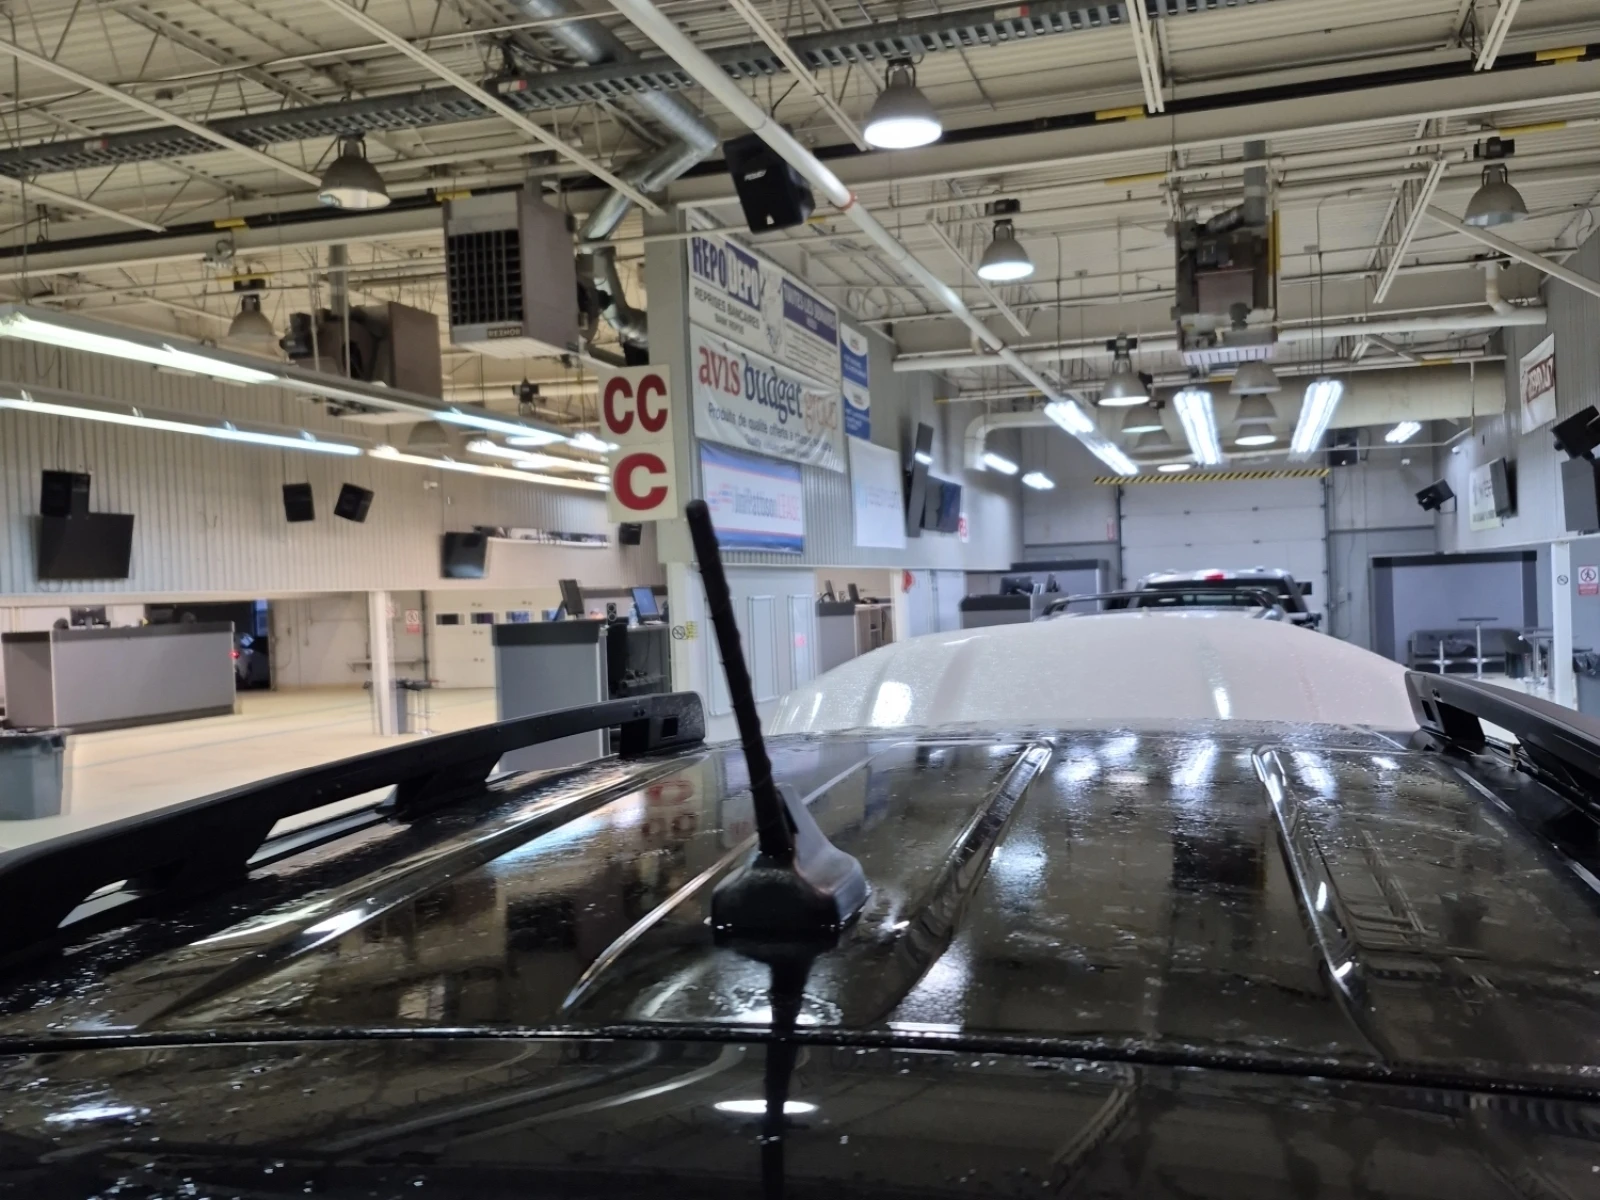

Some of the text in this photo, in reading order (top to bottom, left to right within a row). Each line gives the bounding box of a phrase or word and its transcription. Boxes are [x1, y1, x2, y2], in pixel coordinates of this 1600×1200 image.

[692, 230, 760, 307] REPO DEPO
[488, 327, 521, 337] REZNOR
[694, 286, 760, 330] REPRISES BANCAIRES
[604, 374, 668, 434] CC
[699, 342, 741, 396] avis
[742, 353, 803, 425] budget
[708, 402, 737, 426] Produits
[738, 412, 748, 428] de
[613, 452, 669, 511] C
